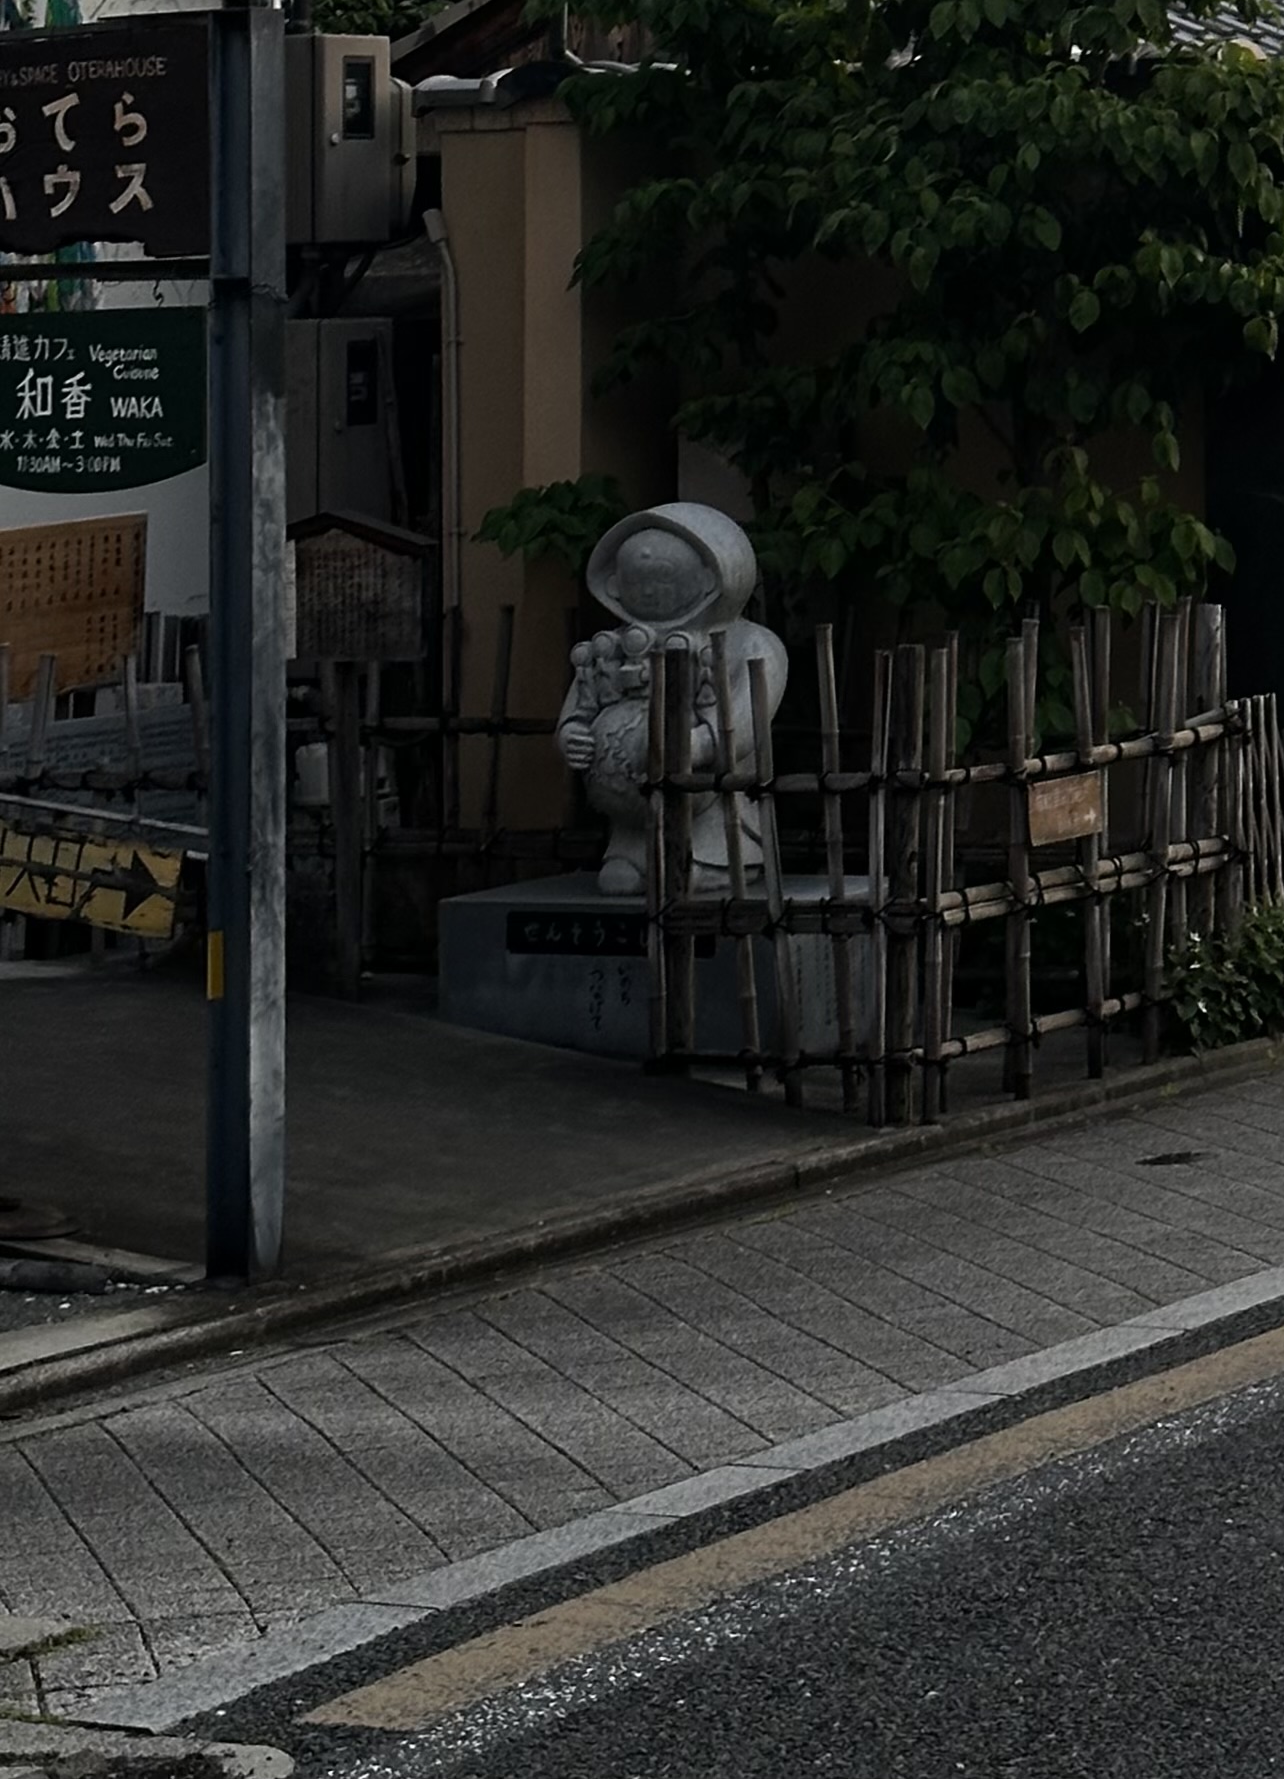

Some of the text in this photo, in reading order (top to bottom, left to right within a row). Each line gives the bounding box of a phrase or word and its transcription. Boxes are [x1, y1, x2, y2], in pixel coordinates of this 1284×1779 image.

[67, 56, 168, 83] OTERAHOUSE
[88, 343, 158, 368] Vegetarian
[15, 366, 93, 421] 和香
[109, 395, 164, 420] WAKA
[0, 827, 86, 909] 入口
